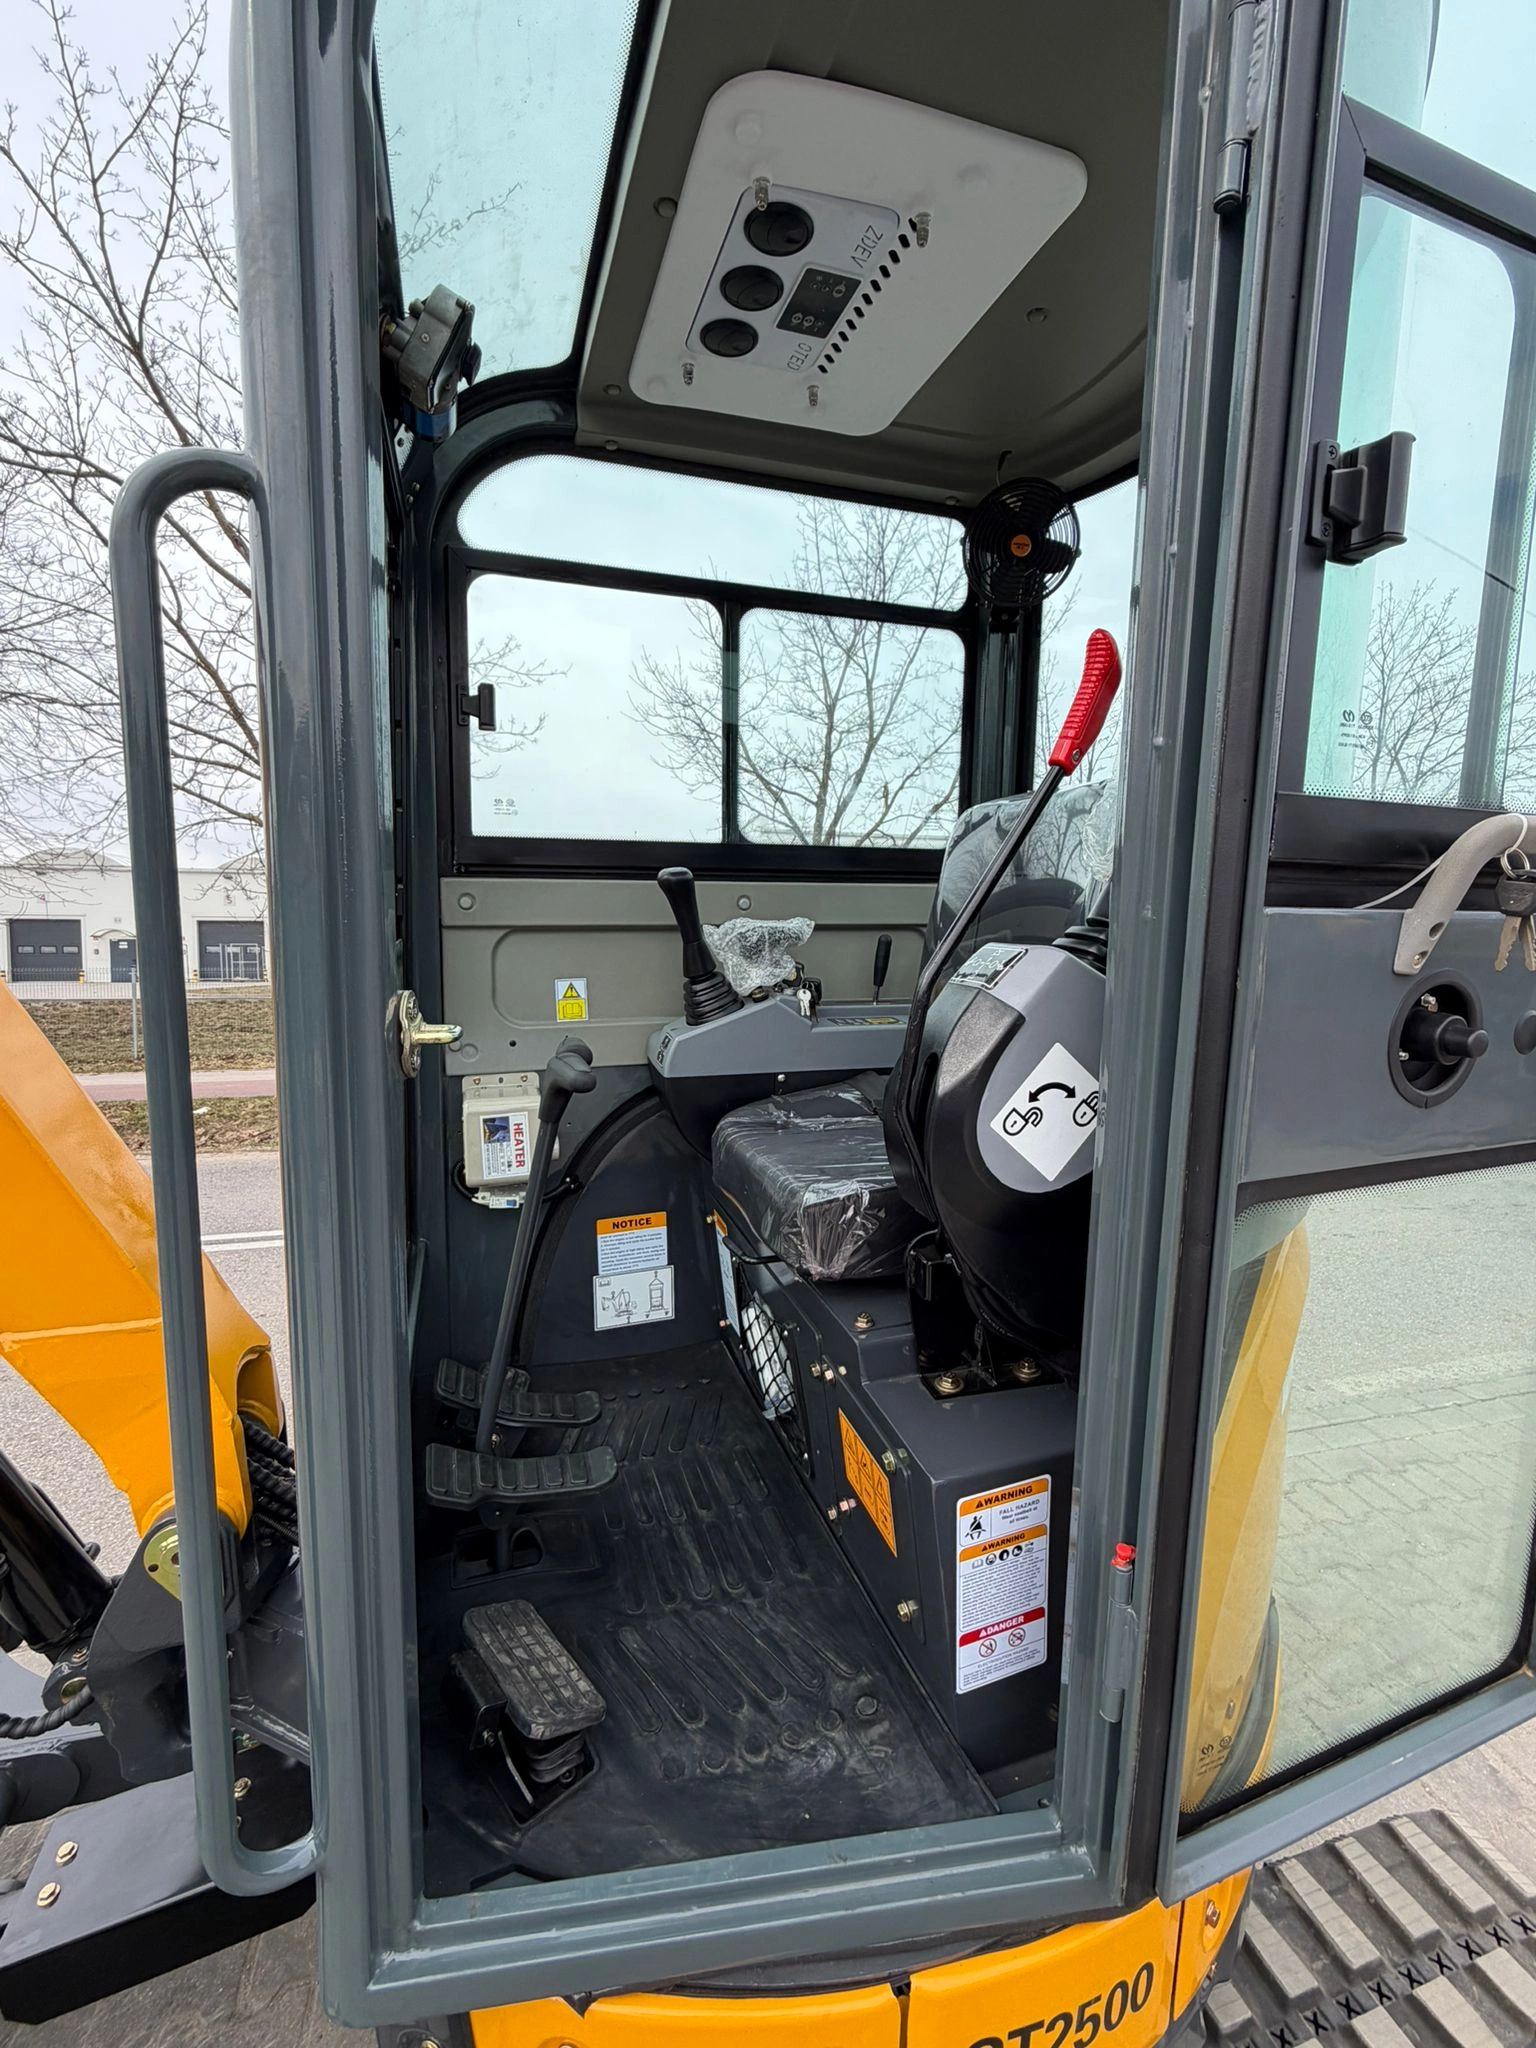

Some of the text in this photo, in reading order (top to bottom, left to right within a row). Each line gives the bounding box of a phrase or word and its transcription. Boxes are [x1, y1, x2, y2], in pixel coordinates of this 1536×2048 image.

[513, 1122, 526, 1168] HEATER
[612, 1217, 652, 1230] NOTICE
[983, 1485, 1033, 1506] WARNING
[999, 1499, 1040, 1516] FALL HAZARD
[987, 1532, 1025, 1550] WARNING
[987, 1615, 1025, 1636] DANGER
